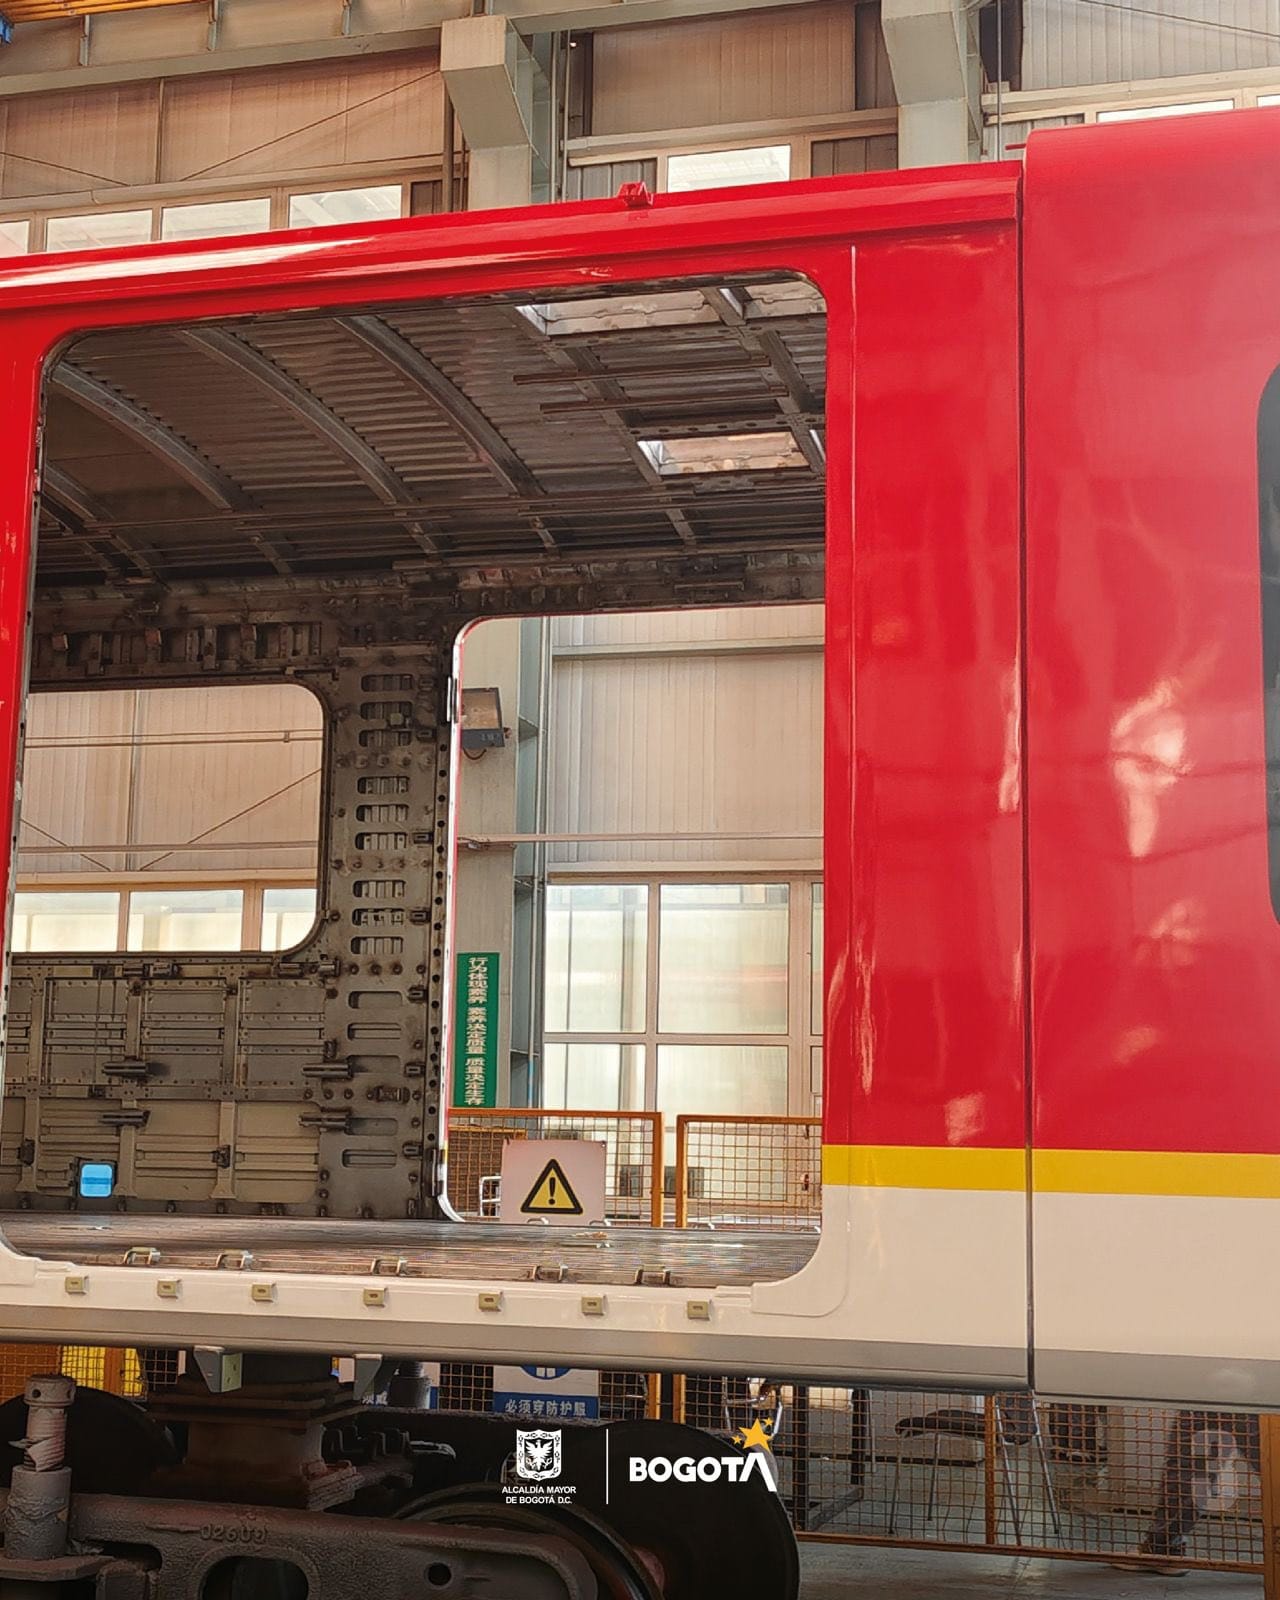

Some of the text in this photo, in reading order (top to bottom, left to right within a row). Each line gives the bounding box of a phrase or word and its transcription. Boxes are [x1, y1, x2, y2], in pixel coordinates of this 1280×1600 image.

[463, 957, 489, 1106] 行为体现素养 素养决定质量 质量决定生存
[505, 1399, 587, 1417] 必须穿防护服
